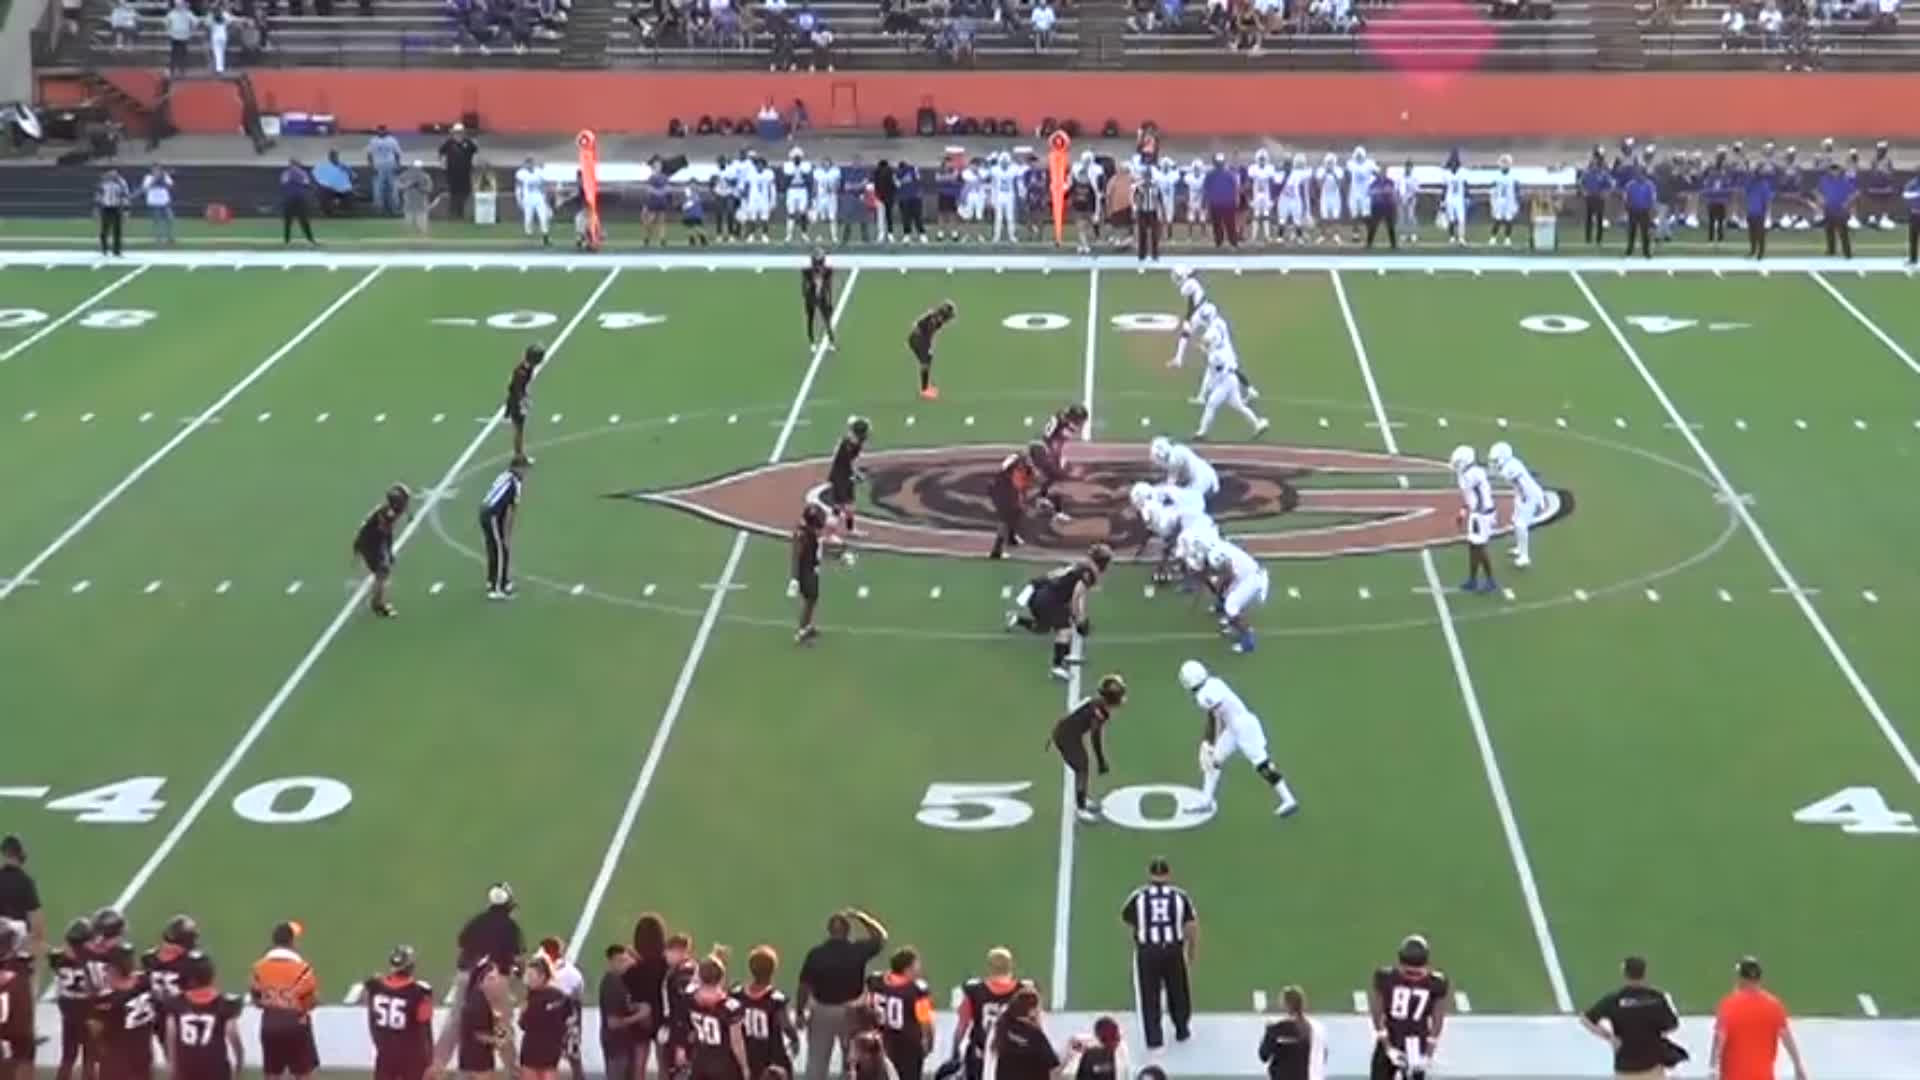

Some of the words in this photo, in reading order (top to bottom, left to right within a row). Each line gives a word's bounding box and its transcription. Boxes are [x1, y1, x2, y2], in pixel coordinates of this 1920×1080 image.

[44, 775, 353, 824] 40
[914, 781, 1217, 830] 50
[1150, 898, 1171, 923] H
[372, 994, 406, 1030] 56
[1391, 986, 1430, 1022] 87
[179, 1014, 216, 1047] 67
